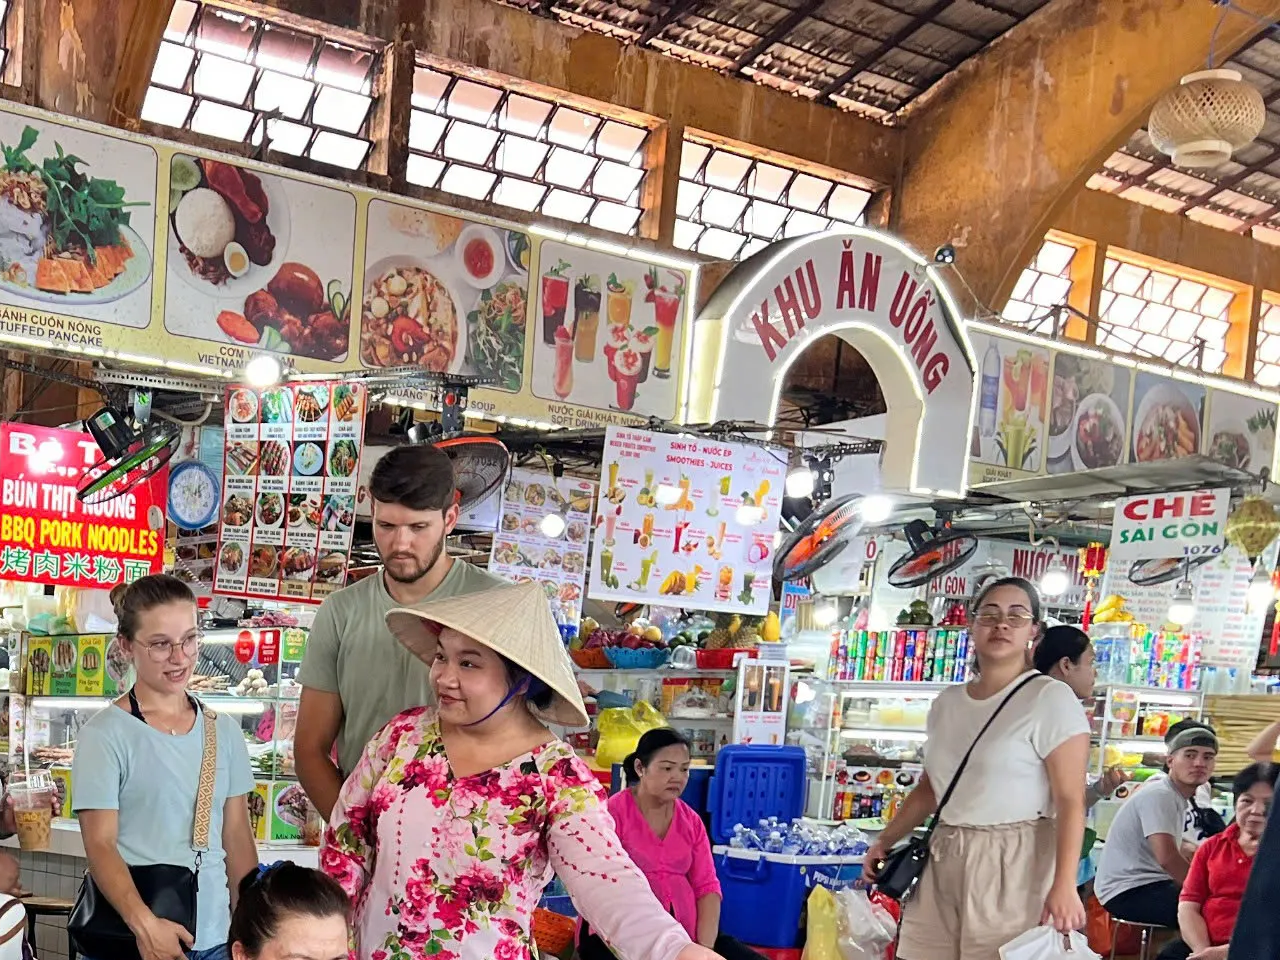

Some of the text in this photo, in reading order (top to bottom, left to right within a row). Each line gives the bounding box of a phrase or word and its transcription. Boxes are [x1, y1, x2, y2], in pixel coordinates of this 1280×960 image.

[30, 312, 63, 330] CUỐN
[67, 317, 102, 336] NÓNG
[751, 239, 950, 395] KHU ĂN UỐNG
[48, 328, 103, 348] PANCAKE
[219, 345, 245, 359] CƠM
[471, 400, 496, 412] SOUP
[548, 404, 574, 416] NƯỚC
[551, 414, 573, 425] SOFT
[670, 441, 687, 451] SINH
[703, 445, 722, 457] NƯỚC
[666, 454, 705, 467] SMOOTHIES
[709, 460, 733, 471] JUICES
[2, 473, 38, 510] BÚN
[41, 483, 79, 518] THỊT
[1123, 490, 1216, 521] CHÈ
[1, 515, 158, 556] BBQ PORK NOODLES
[1163, 517, 1218, 539] GÒN
[1183, 545, 1221, 556] 1076
